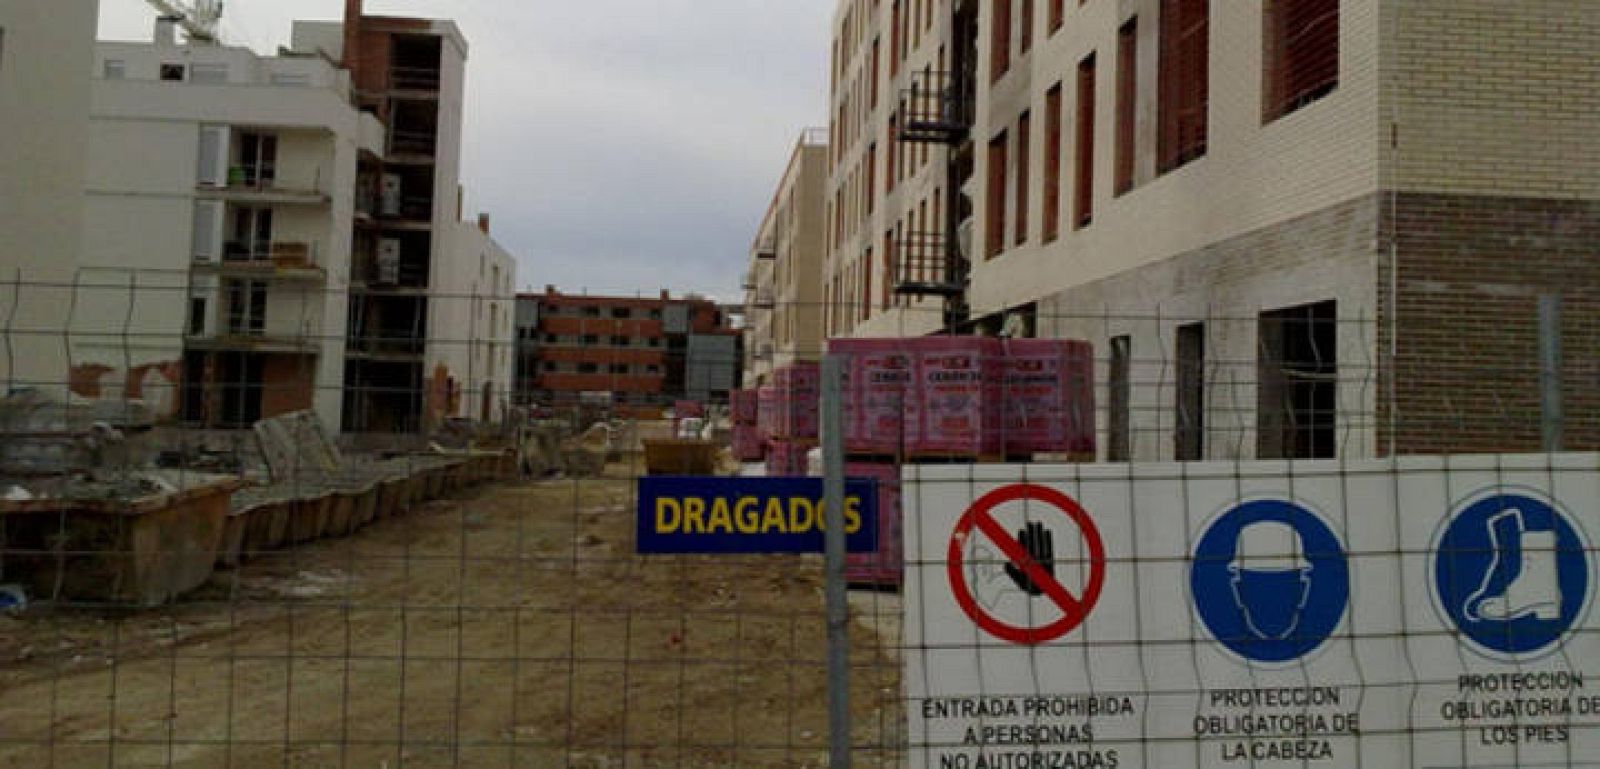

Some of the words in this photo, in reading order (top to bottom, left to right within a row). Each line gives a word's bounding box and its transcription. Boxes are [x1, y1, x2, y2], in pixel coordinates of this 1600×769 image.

[922, 697, 1019, 719] ENTRADA
[1024, 696, 1134, 717] PROHIBIDA
[1441, 698, 1572, 720] OBLIGATORIA
[1578, 697, 1600, 715] DE
[1193, 713, 1329, 734] OBLIGATORIA
[1333, 713, 1359, 733] DE
[965, 727, 977, 745] A
[983, 725, 1094, 745] PERSONAS
[1481, 727, 1518, 745] LOS
[1525, 725, 1569, 743] PIES
[940, 754, 967, 769] NO
[975, 750, 1119, 769] AUTORIZADAS
[1221, 743, 1247, 760] LA
[1251, 740, 1333, 760] CABEZA
